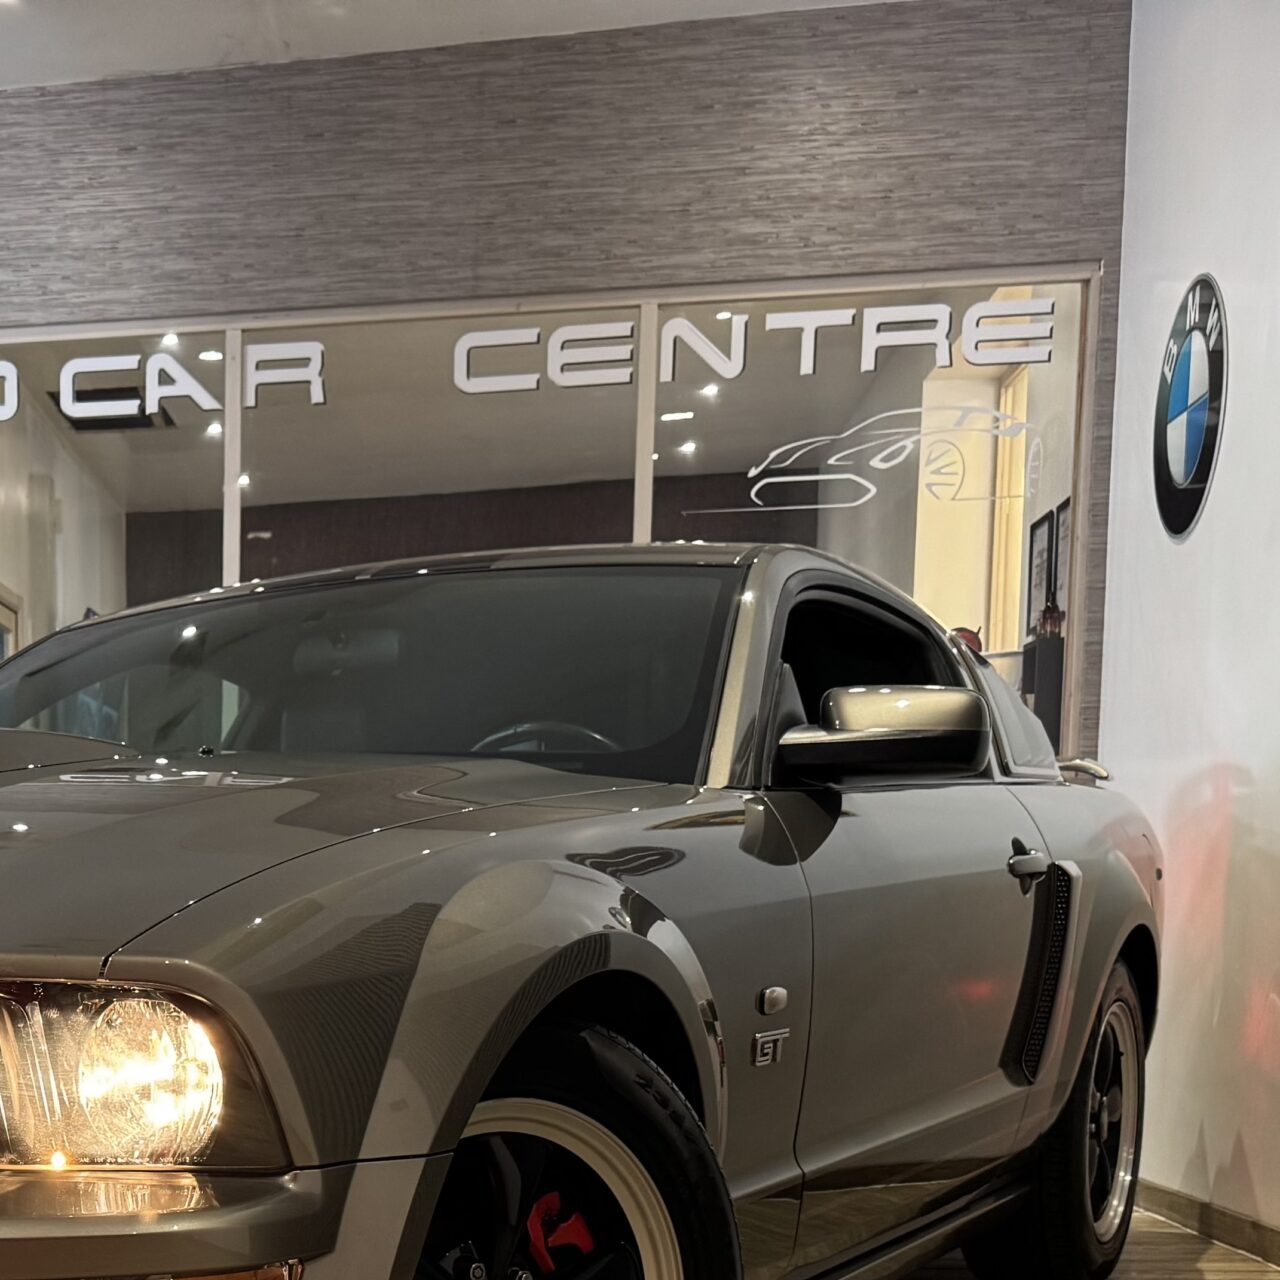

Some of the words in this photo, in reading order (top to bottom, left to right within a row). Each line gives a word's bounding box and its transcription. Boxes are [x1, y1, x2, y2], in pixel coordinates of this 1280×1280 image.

[59, 341, 326, 419] CAR
[453, 298, 1056, 394] CENTRE
[1163, 284, 1221, 385] BMW
[756, 1028, 790, 1067] GT
